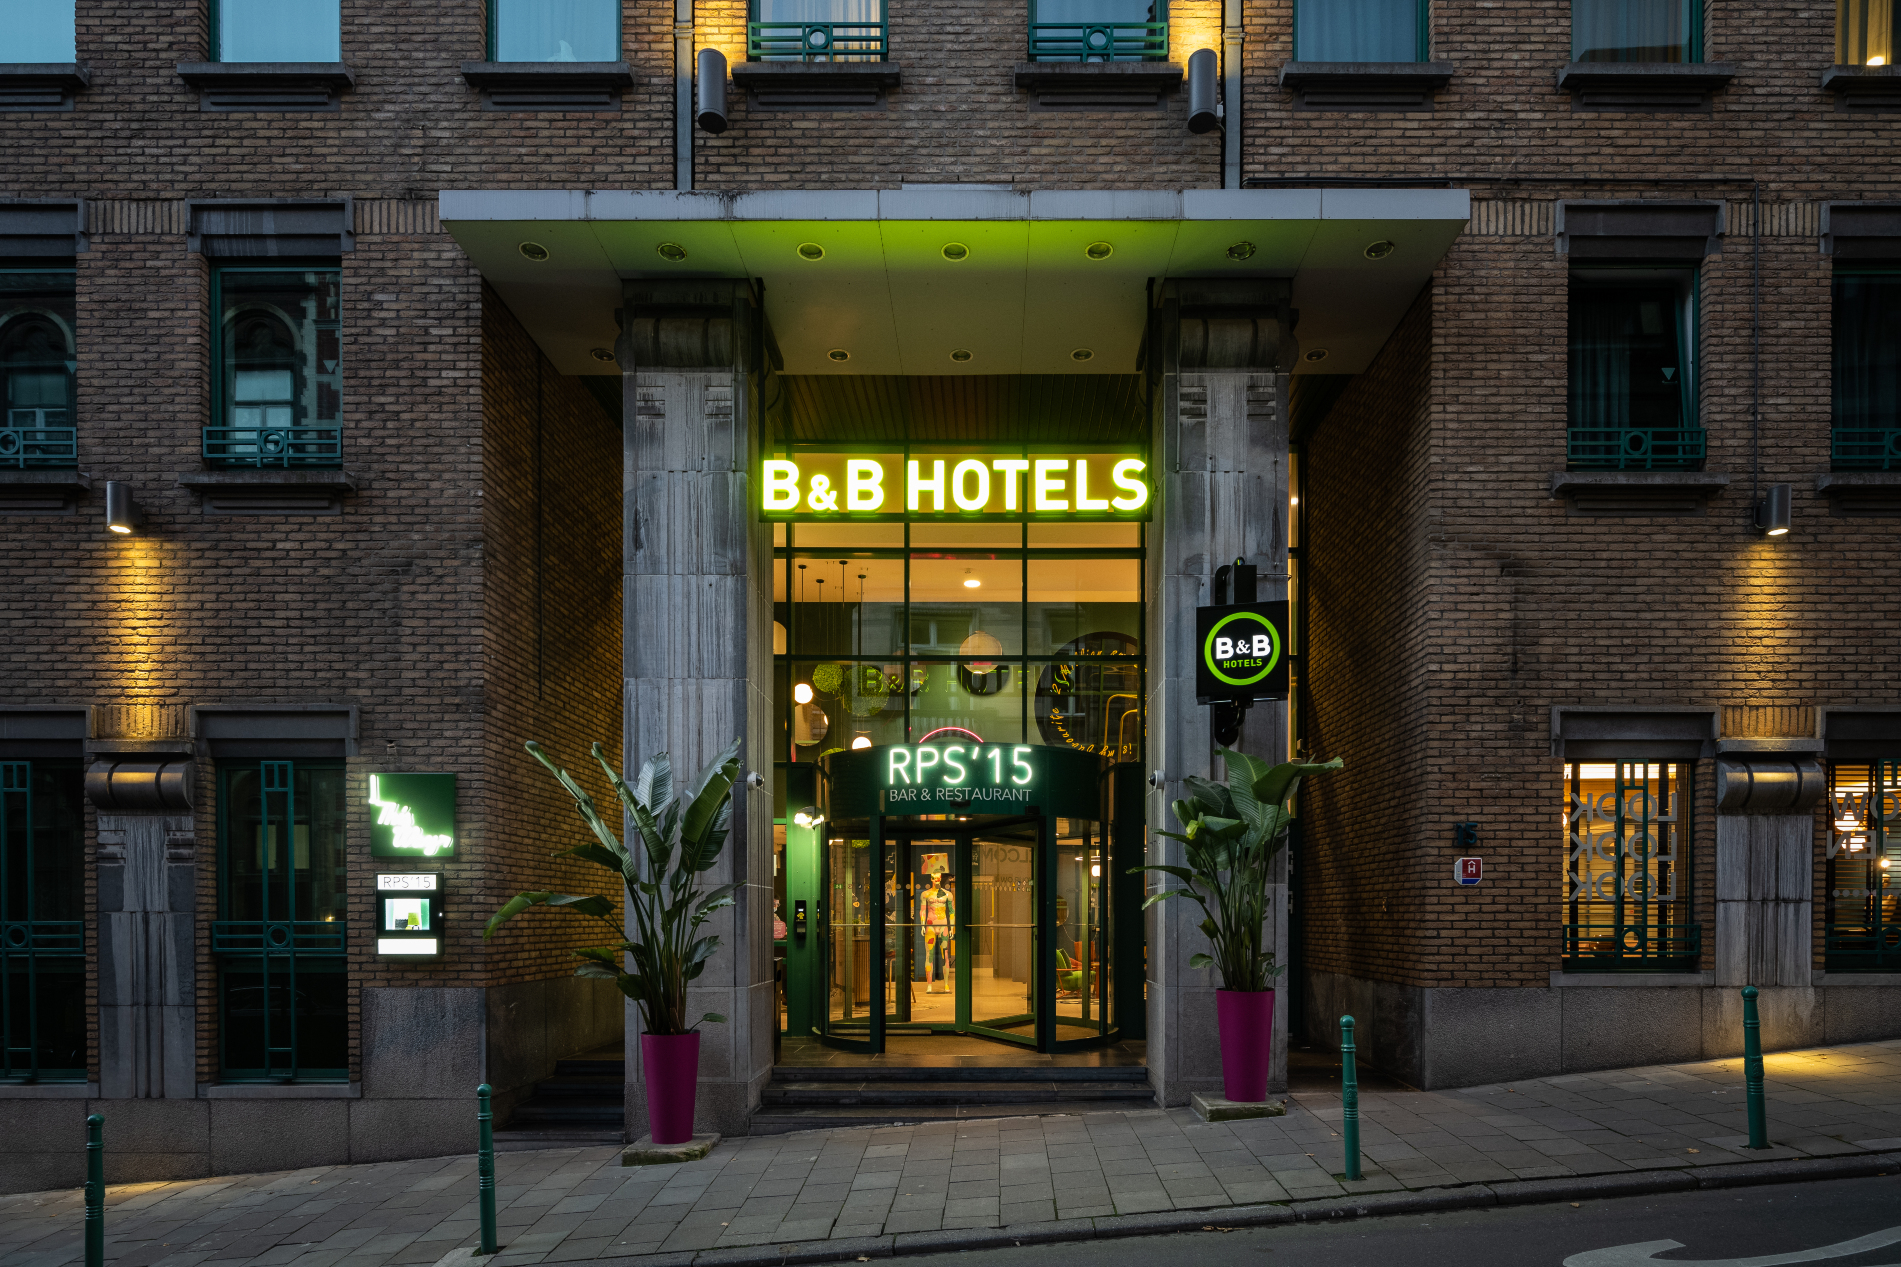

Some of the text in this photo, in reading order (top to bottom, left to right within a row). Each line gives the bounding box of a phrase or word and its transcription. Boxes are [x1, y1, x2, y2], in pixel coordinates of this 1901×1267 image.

[763, 458, 1148, 511] B&B HOTELS
[1216, 635, 1270, 659] B&B
[1223, 658, 1262, 668] HOTELS
[889, 746, 1033, 784] RPS'15
[889, 787, 1032, 801] BAR & RESTAURANT
[1456, 822, 1478, 846] 15
[383, 876, 431, 889] RPS'15
